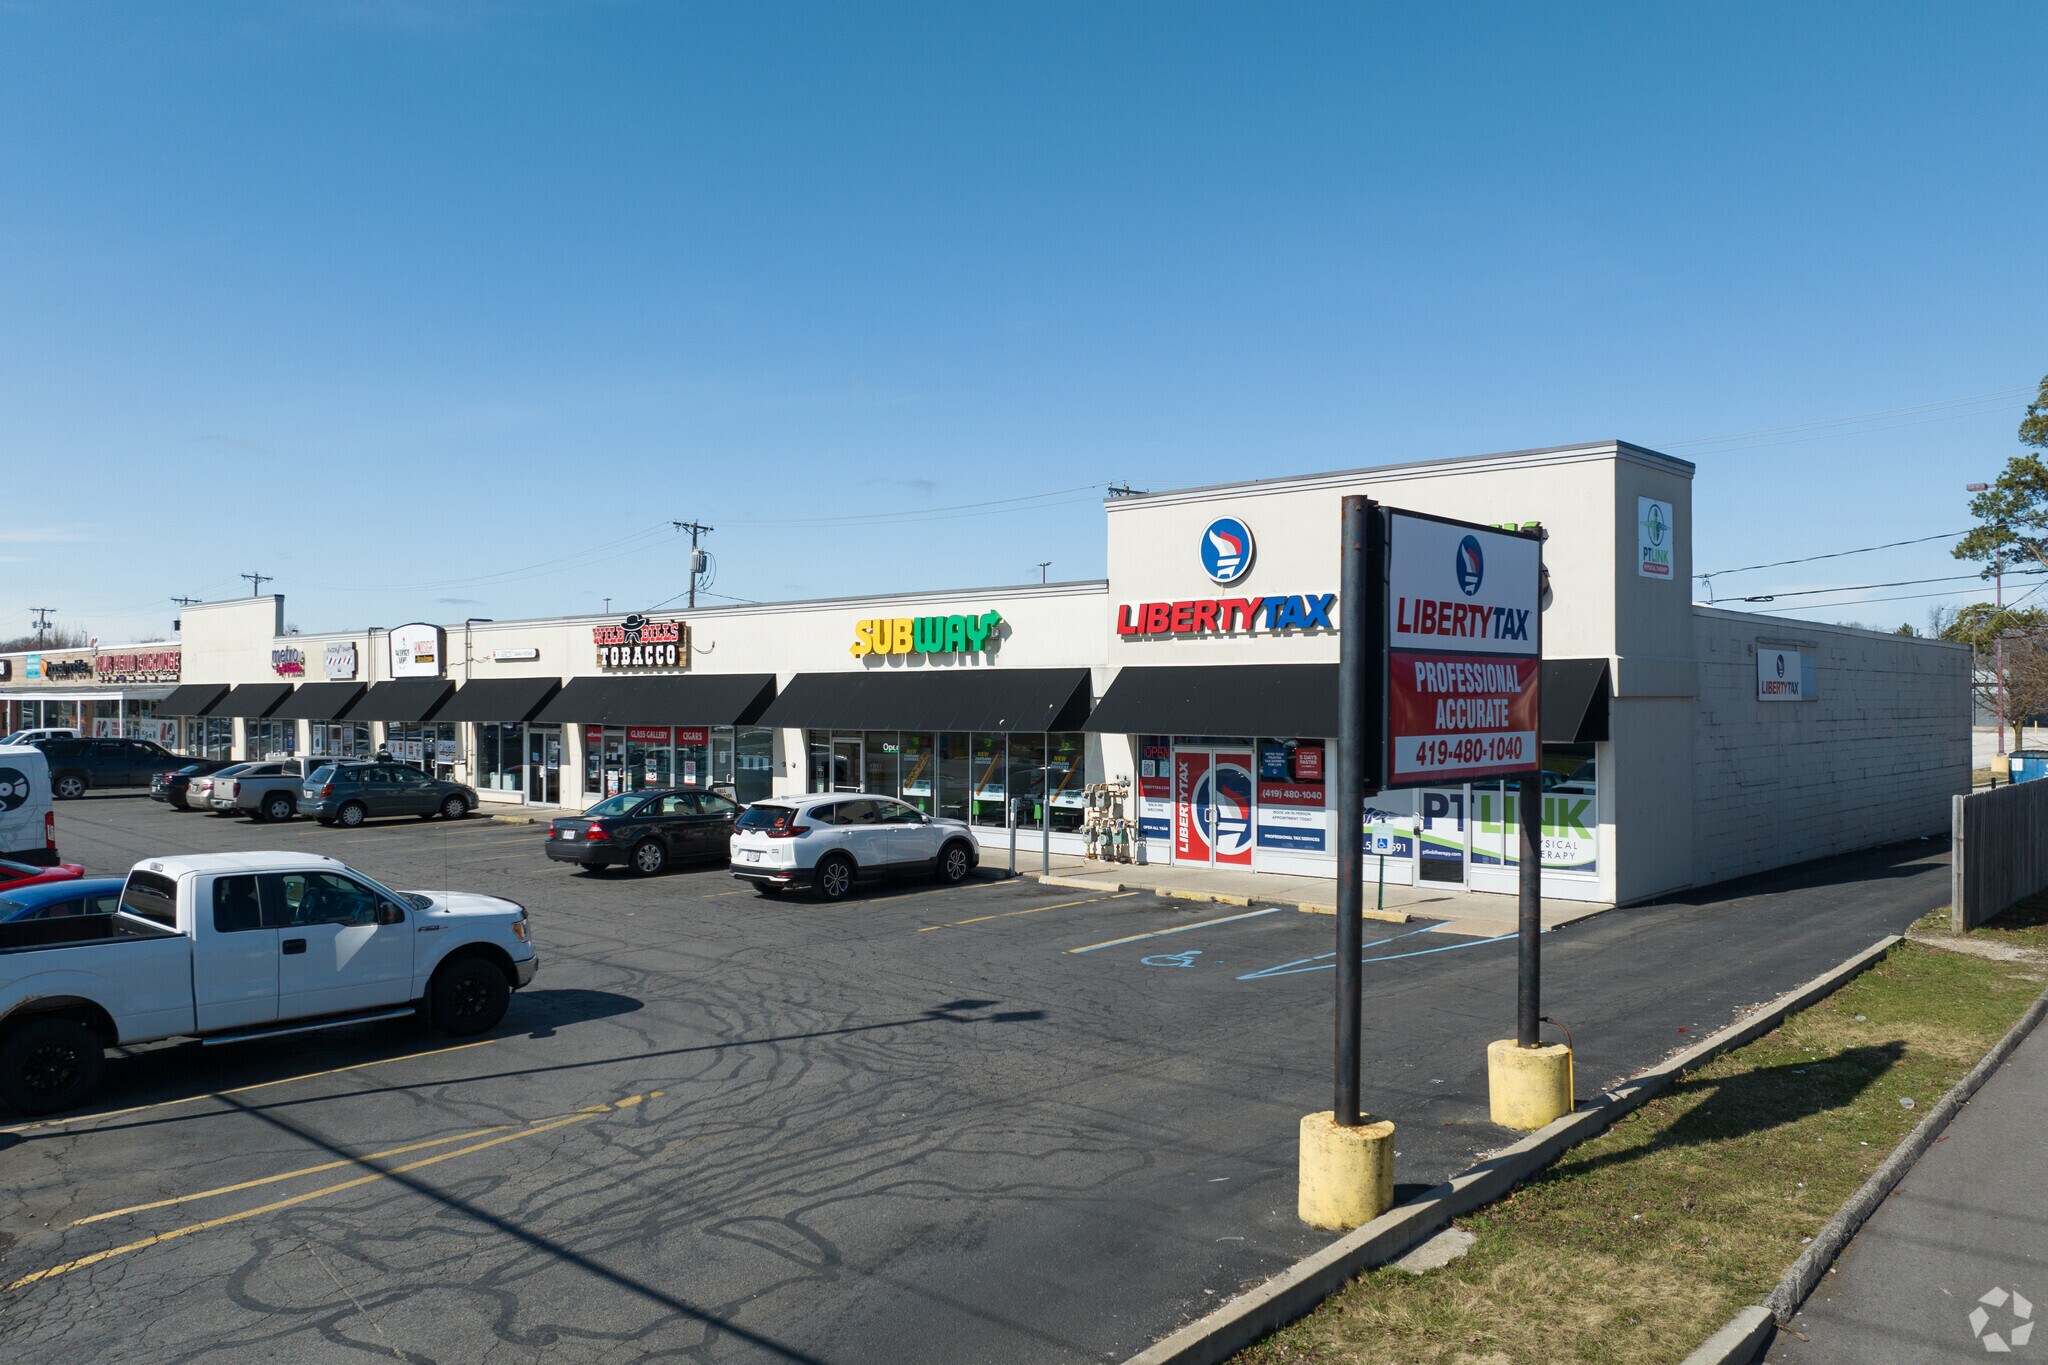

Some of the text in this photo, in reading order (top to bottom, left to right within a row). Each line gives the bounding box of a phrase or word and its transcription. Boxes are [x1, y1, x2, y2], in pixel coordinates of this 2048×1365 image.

[1117, 593, 1335, 635] LIBERTYTAX
[1397, 597, 1529, 641] LIBERTYTAX
[592, 622, 679, 645] WILD BILL'S
[849, 609, 1003, 658] SUBWAY
[138, 651, 180, 671] EXCHANGE
[272, 646, 299, 662] metro
[600, 644, 676, 665] TOBACCO
[1414, 661, 1521, 693] PROFESSIONAL
[1435, 698, 1509, 730] ACCURATE
[631, 730, 668, 739] GLASS GALLERY
[683, 732, 703, 741] CIGARS
[1145, 747, 1170, 758] OPEN
[1416, 735, 1523, 767] 419-480-1040
[1262, 789, 1322, 800] (419) 480-1040
[1179, 762, 1189, 853] LIBERTYTAX
